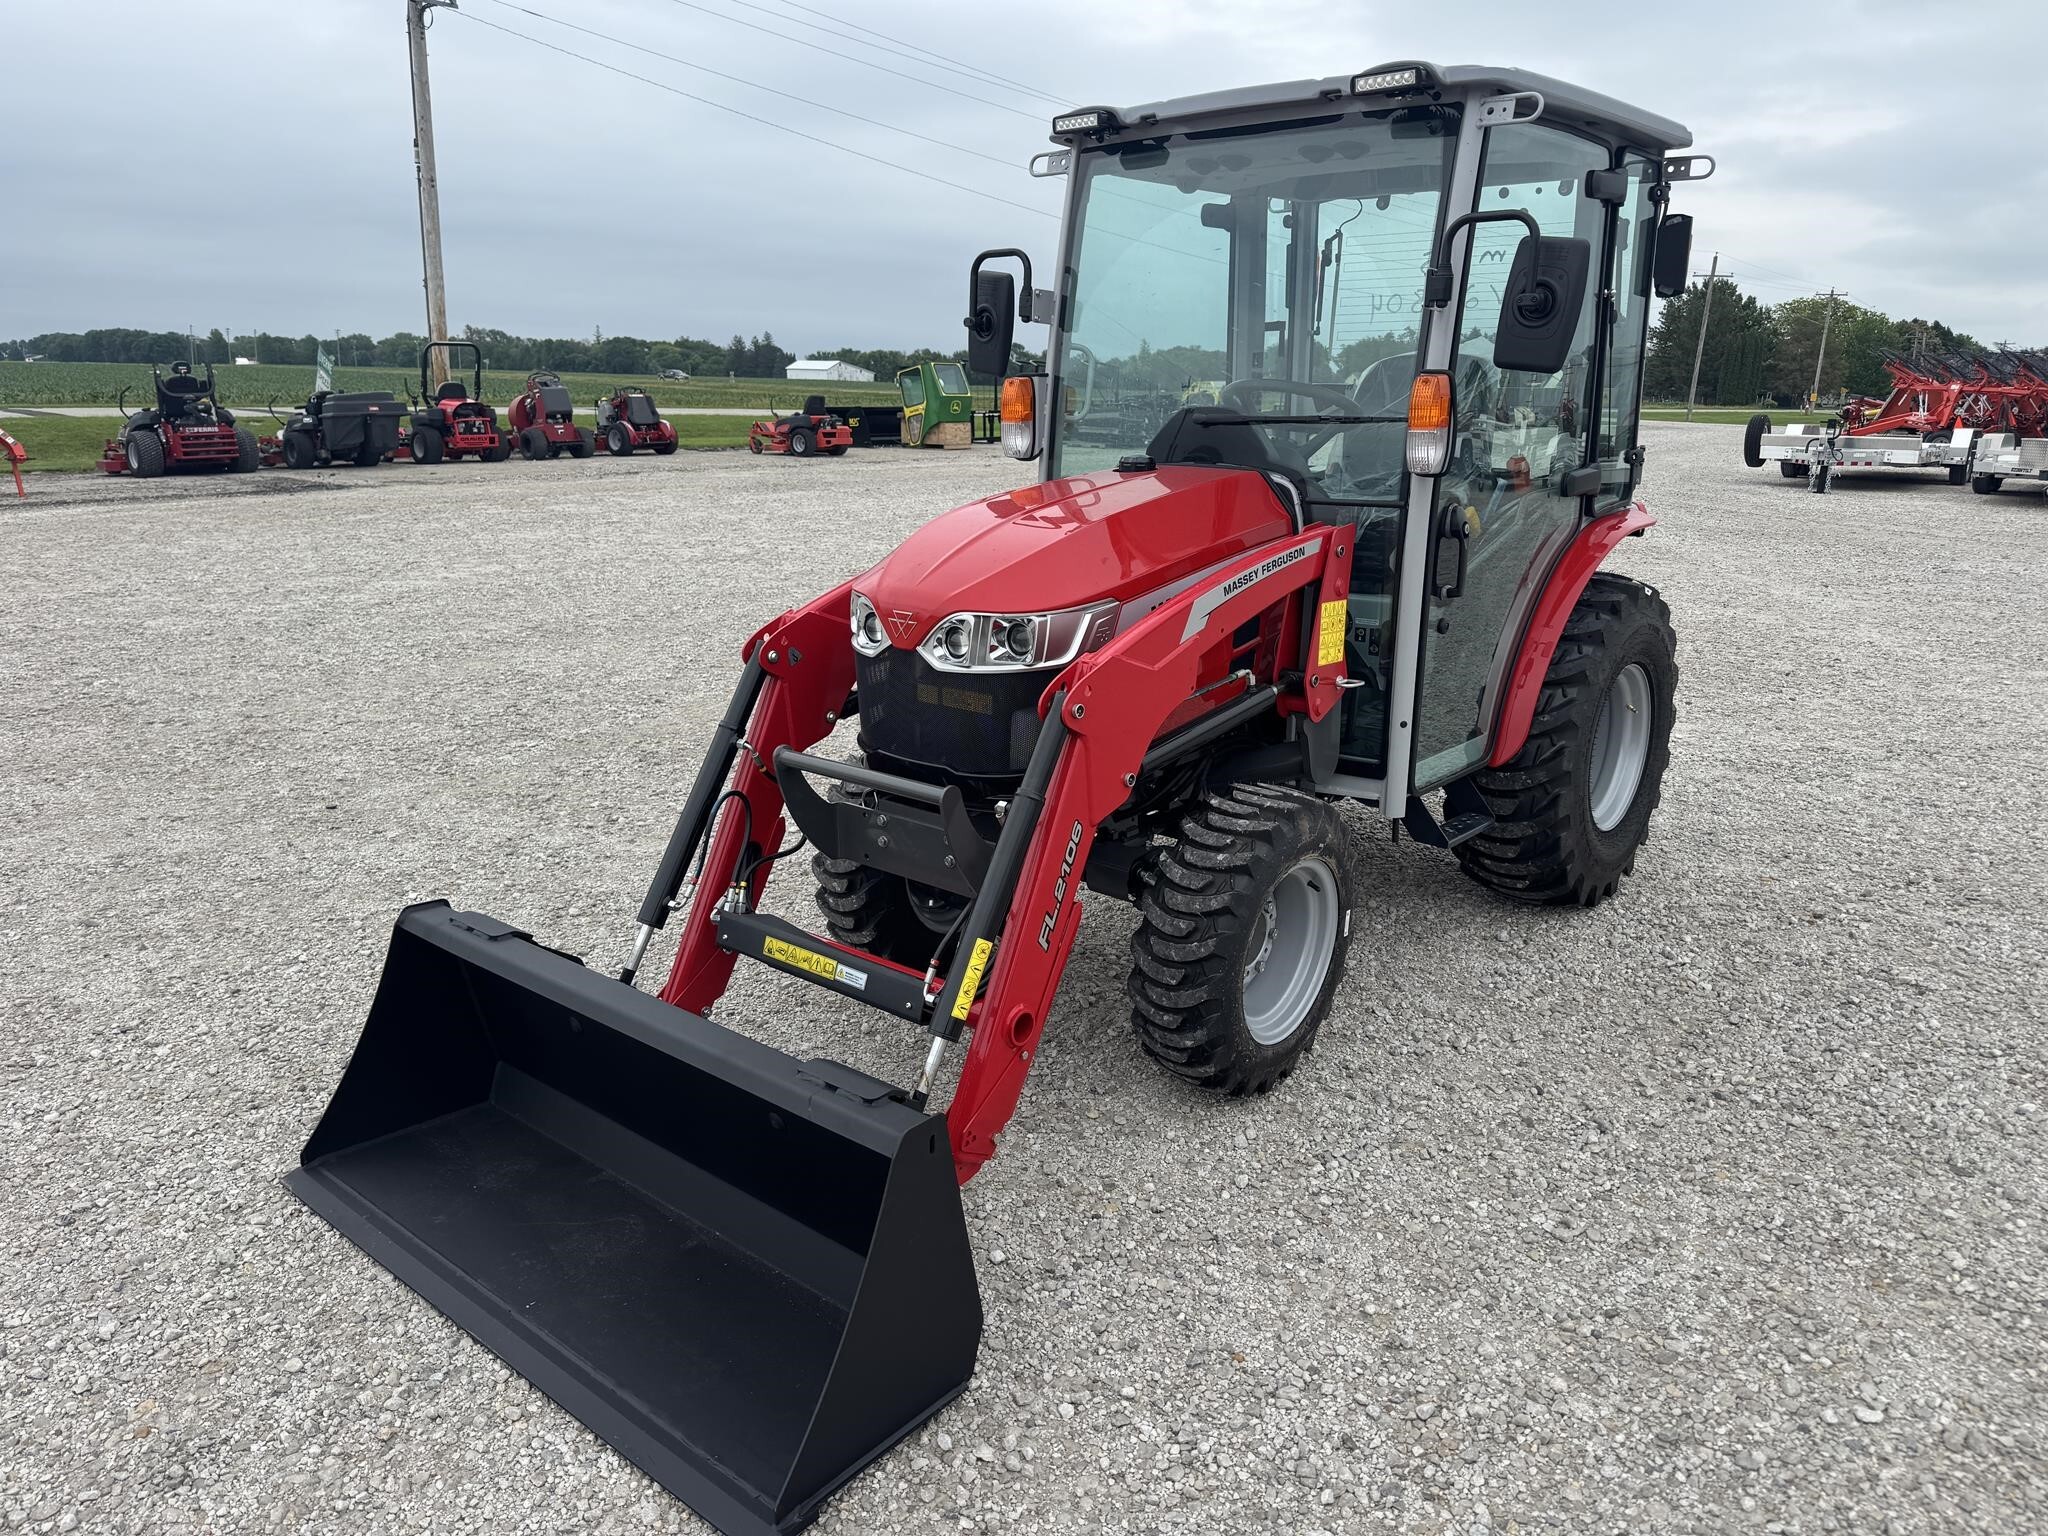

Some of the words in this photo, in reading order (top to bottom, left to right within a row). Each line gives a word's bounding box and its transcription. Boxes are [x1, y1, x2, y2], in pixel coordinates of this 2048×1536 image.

[1223, 568, 1260, 597] MASSEY
[1261, 546, 1306, 576] FERGUSON
[1038, 819, 1083, 953] FL.2106
